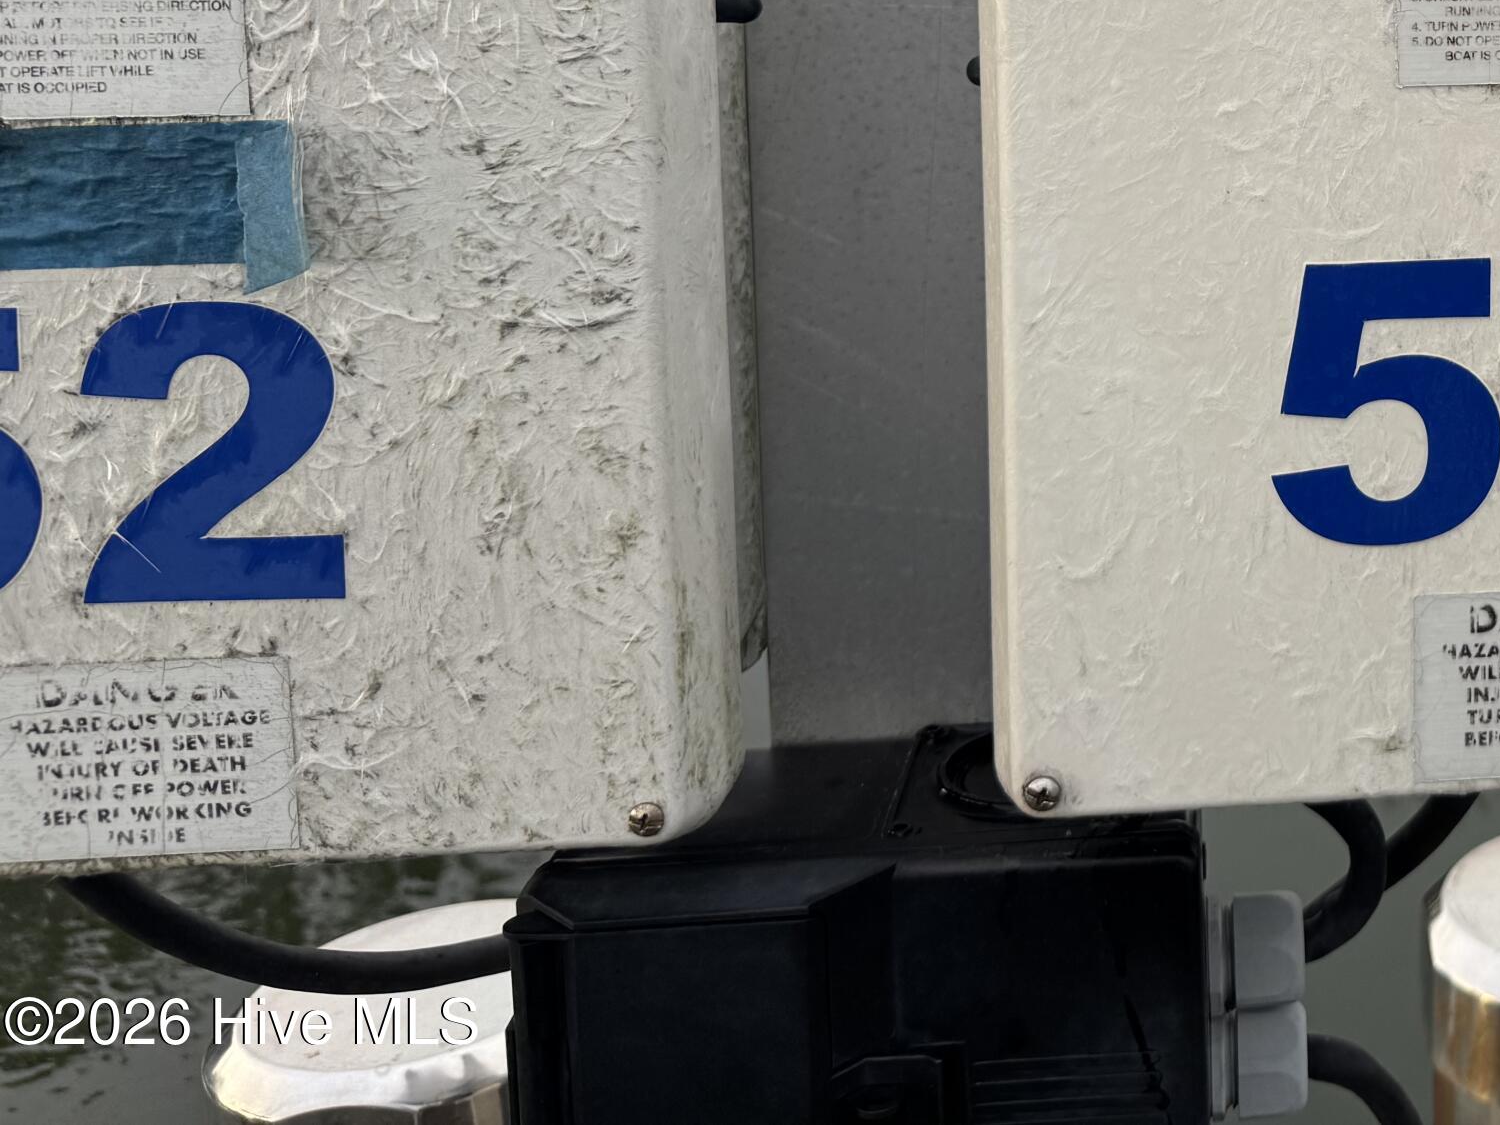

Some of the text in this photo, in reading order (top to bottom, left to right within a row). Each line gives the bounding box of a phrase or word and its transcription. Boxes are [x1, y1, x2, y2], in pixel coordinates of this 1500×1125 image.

[1411, 22, 1422, 32] 4.
[1425, 21, 1459, 32] TURN
[1425, 36, 1443, 46] DO
[1447, 35, 1472, 46] NOT
[128, 49, 156, 60] NOT
[160, 49, 174, 60] IN
[1445, 50, 1477, 61] BOAT
[1481, 50, 1491, 61] IS
[10, 65, 75, 77] OPERATE
[17, 82, 31, 94] IS
[34, 81, 107, 94] OCCUPIED
[9, 709, 272, 735] HAZARDOUS VOLTAGE
[172, 732, 254, 752] SEVERE
[173, 755, 247, 773] DEATH
[131, 801, 253, 822] WORKING
[108, 827, 186, 846] INSIE
